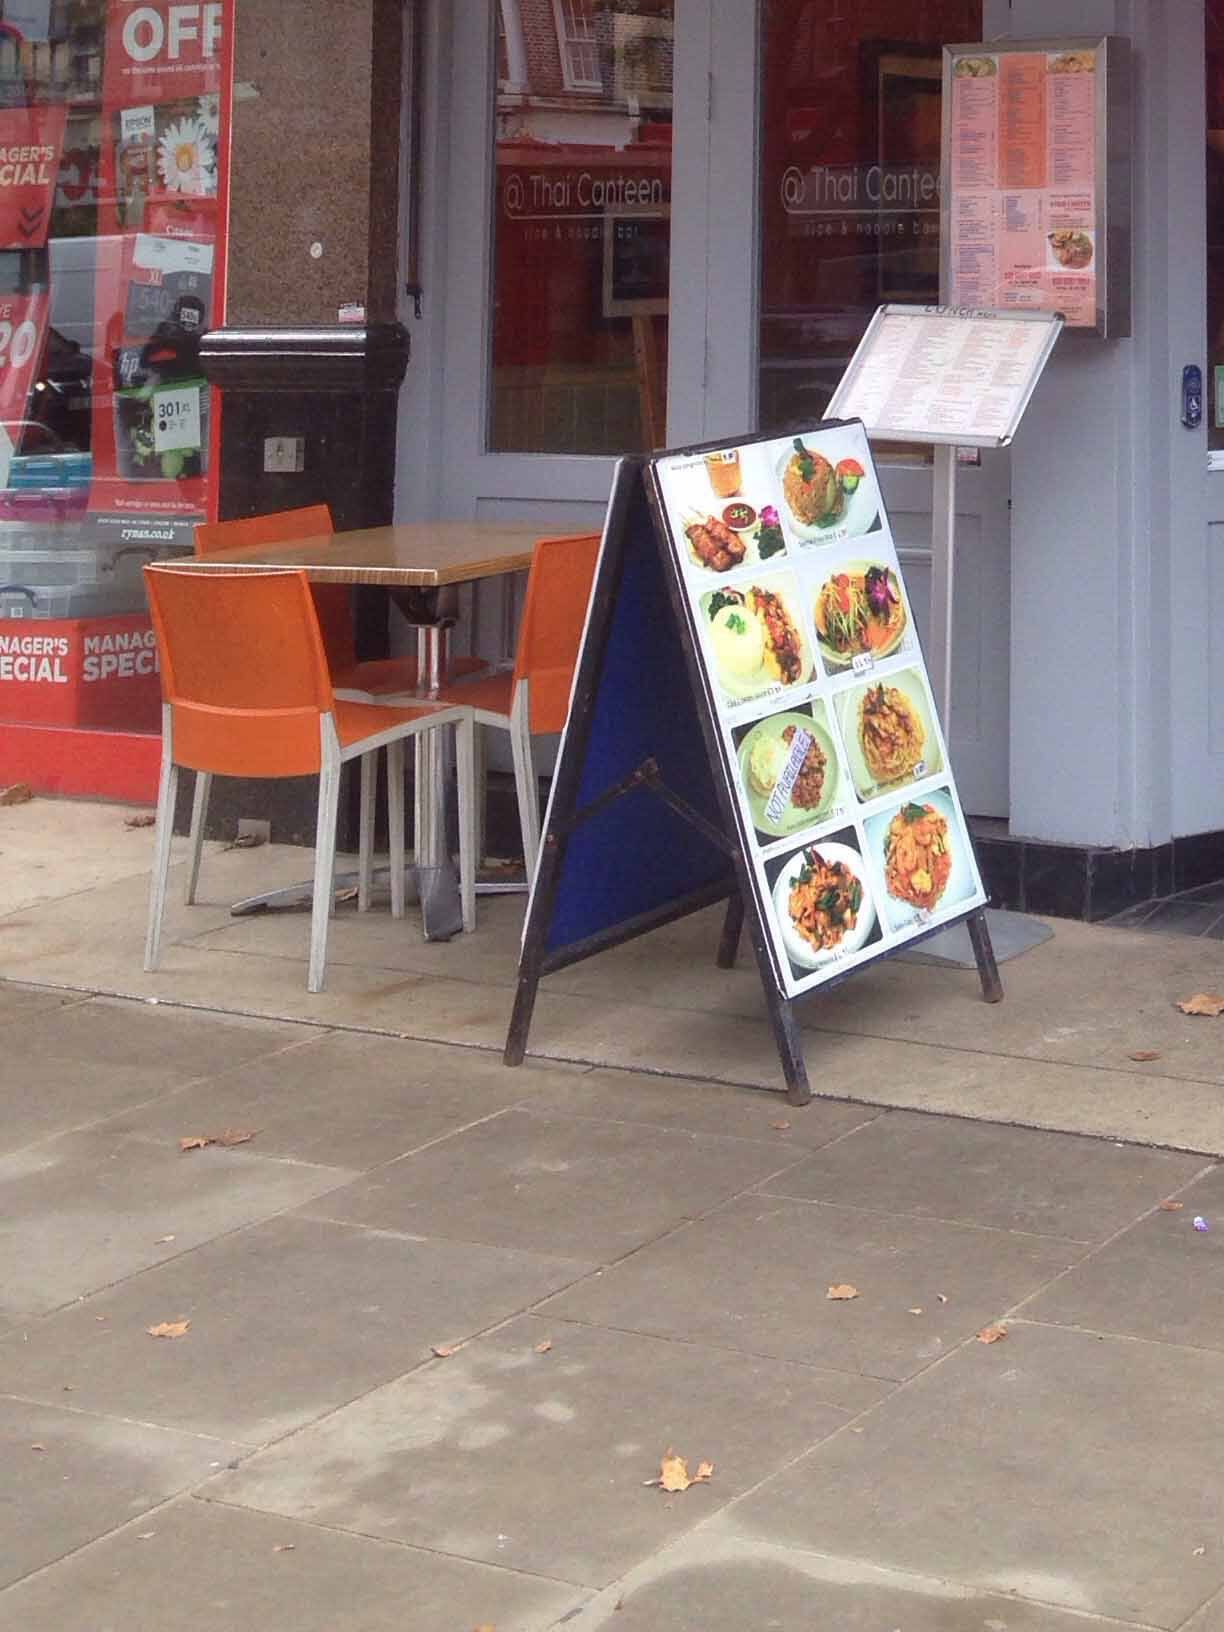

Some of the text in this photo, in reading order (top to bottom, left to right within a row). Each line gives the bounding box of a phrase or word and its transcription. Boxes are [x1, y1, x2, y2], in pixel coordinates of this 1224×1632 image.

[121, 3, 223, 62] OFF
[529, 173, 571, 208] Thai
[576, 173, 663, 211] Canteen
[811, 166, 858, 201] Thai
[120, 352, 140, 379] hp
[159, 401, 180, 418] 301
[83, 629, 156, 655] MANAG
[0, 656, 68, 683] ECIAL
[83, 650, 160, 682] SPECI
